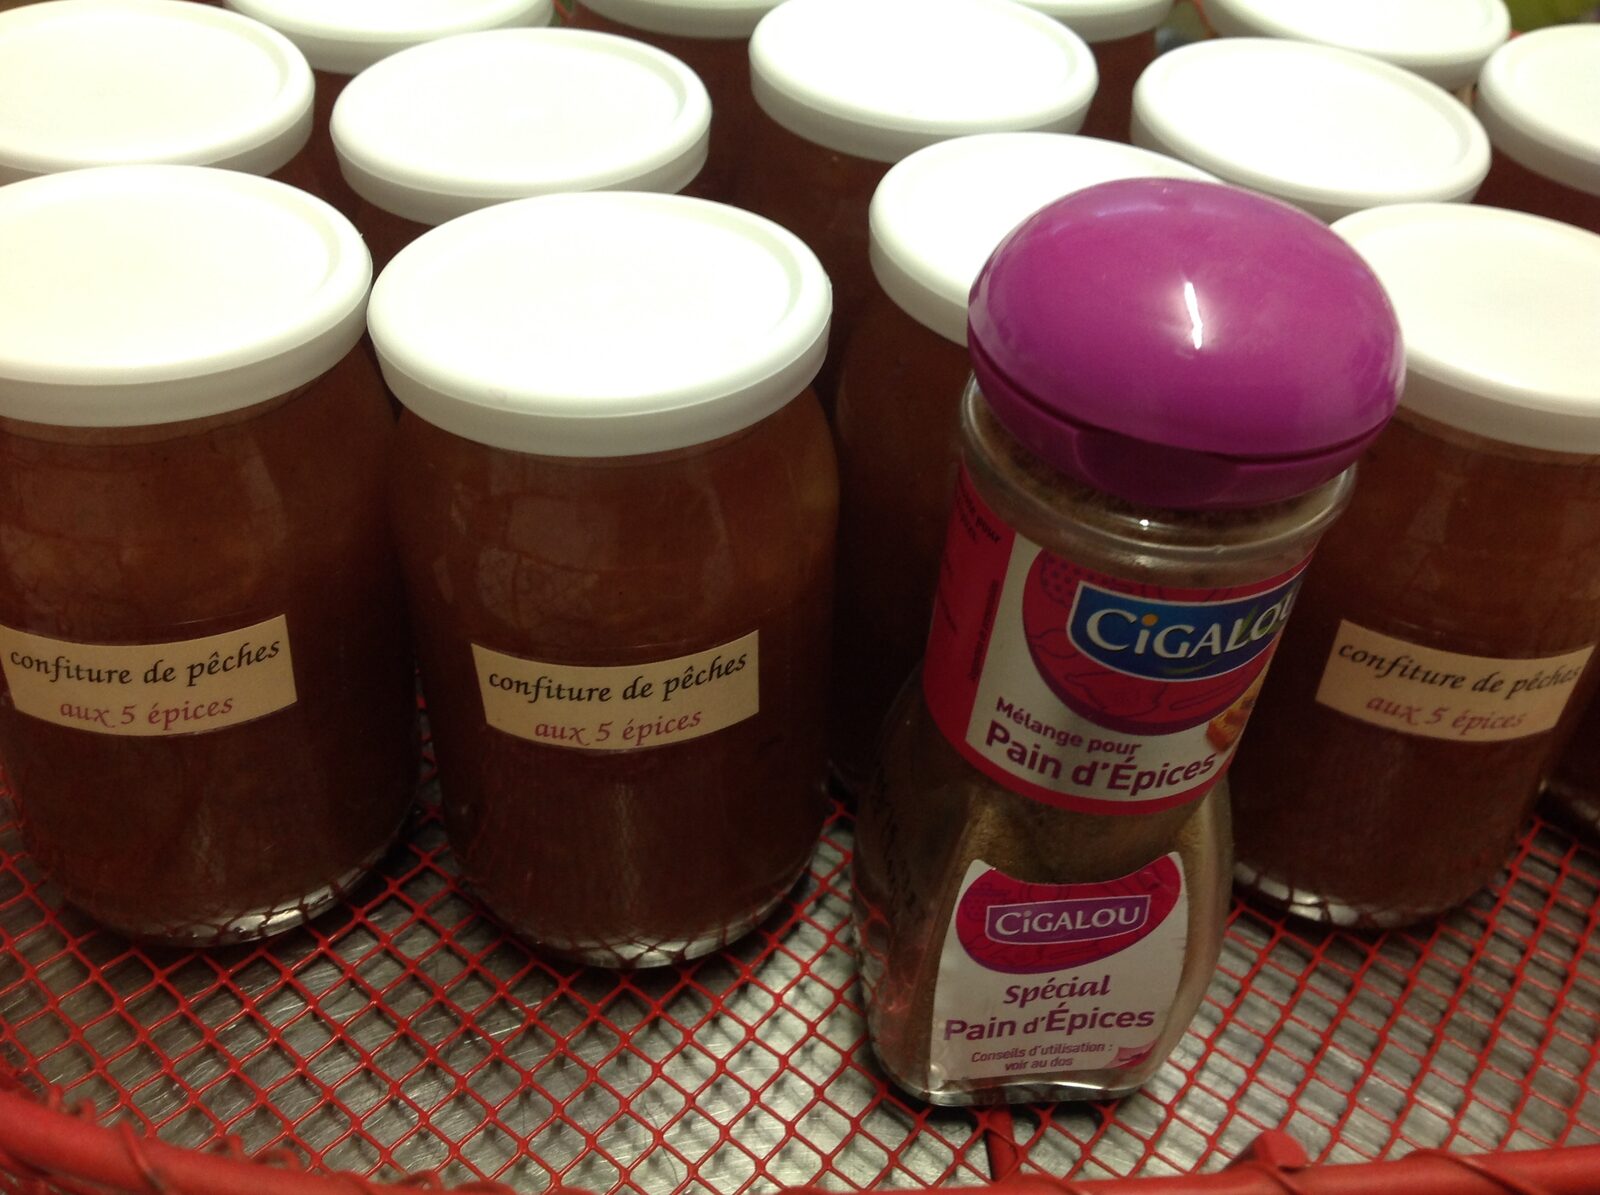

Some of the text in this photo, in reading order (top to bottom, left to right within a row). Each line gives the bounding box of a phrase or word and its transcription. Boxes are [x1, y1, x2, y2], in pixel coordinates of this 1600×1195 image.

[10, 640, 280, 687] confiture de pêches
[488, 652, 747, 704] confiture de pêches
[1338, 644, 1466, 689] confiture
[1471, 672, 1503, 693] de
[60, 696, 234, 730] aux 5 épices
[534, 709, 703, 747] aux 5 épices
[995, 696, 1142, 756] Mélange pour
[1366, 697, 1526, 736] aux 5 épices
[985, 719, 1217, 796] Pain d'Épices
[1003, 975, 1111, 1008] spécial
[943, 1002, 1155, 1041] Pain d'Épices
[971, 1047, 1026, 1063] Conseils
[1028, 1042, 1105, 1057] d'utilisation
[1005, 1056, 1073, 1070] voir au dos
